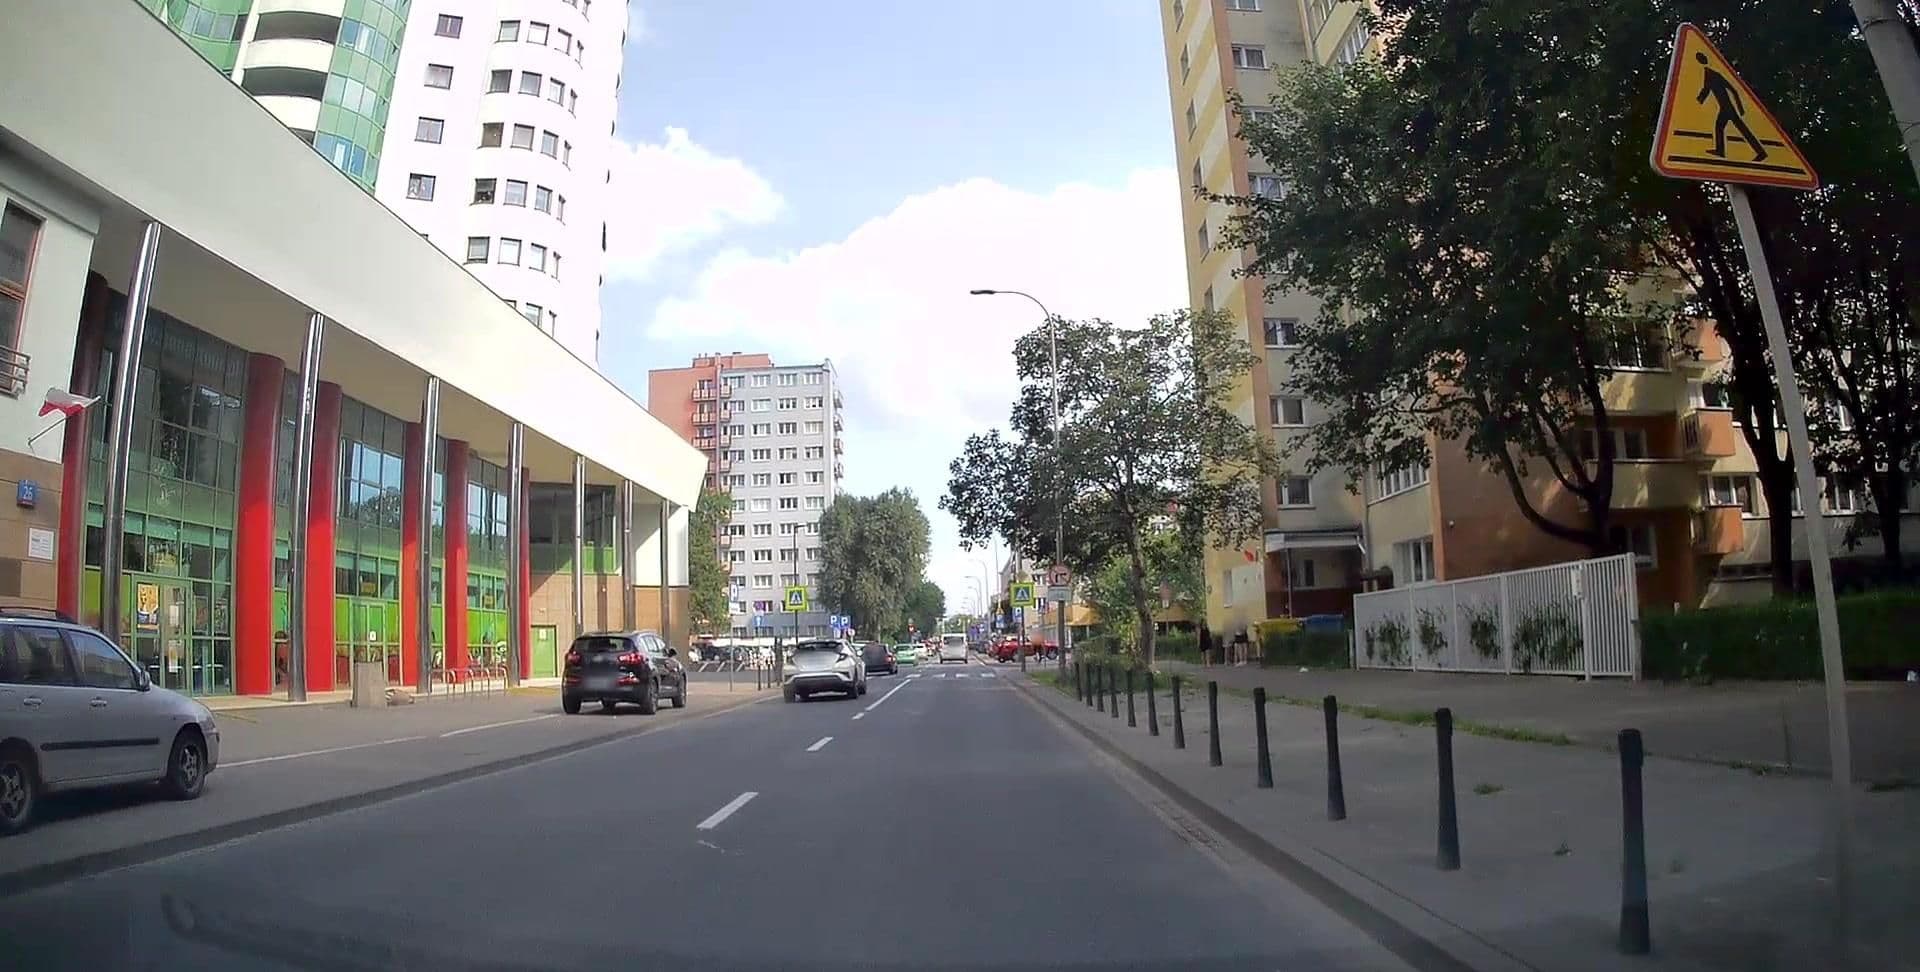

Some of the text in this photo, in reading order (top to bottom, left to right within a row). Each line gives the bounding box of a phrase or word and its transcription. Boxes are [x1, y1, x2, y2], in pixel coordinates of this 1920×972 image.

[23, 486, 33, 500] 26
[830, 615, 837, 625] P
[841, 617, 848, 626] P
